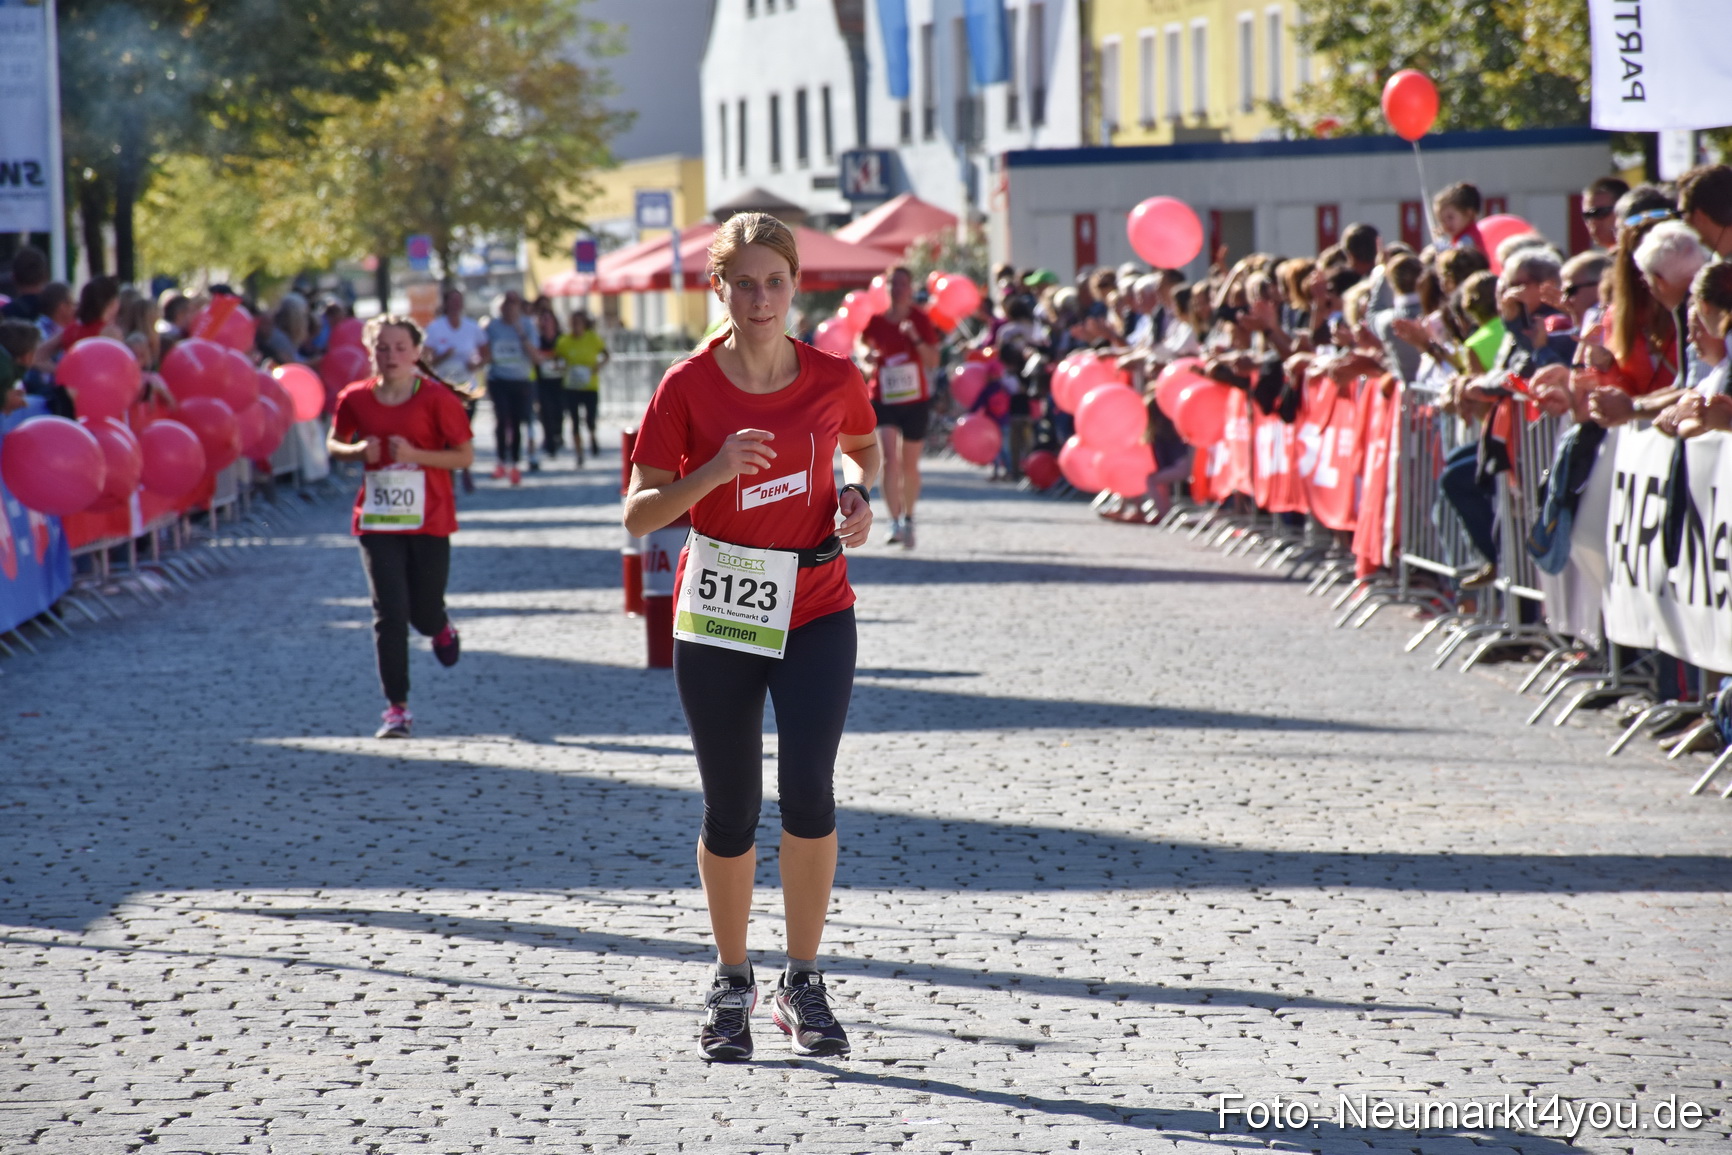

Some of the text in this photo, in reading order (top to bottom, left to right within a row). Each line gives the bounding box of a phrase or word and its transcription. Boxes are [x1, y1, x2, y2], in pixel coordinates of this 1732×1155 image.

[374, 488, 415, 507] 5120
[760, 482, 789, 499] DEHN
[717, 552, 765, 571] BOCK
[699, 568, 778, 611] 5123
[702, 604, 759, 621] PARTL Neumarkt
[706, 620, 757, 641] Carmen
